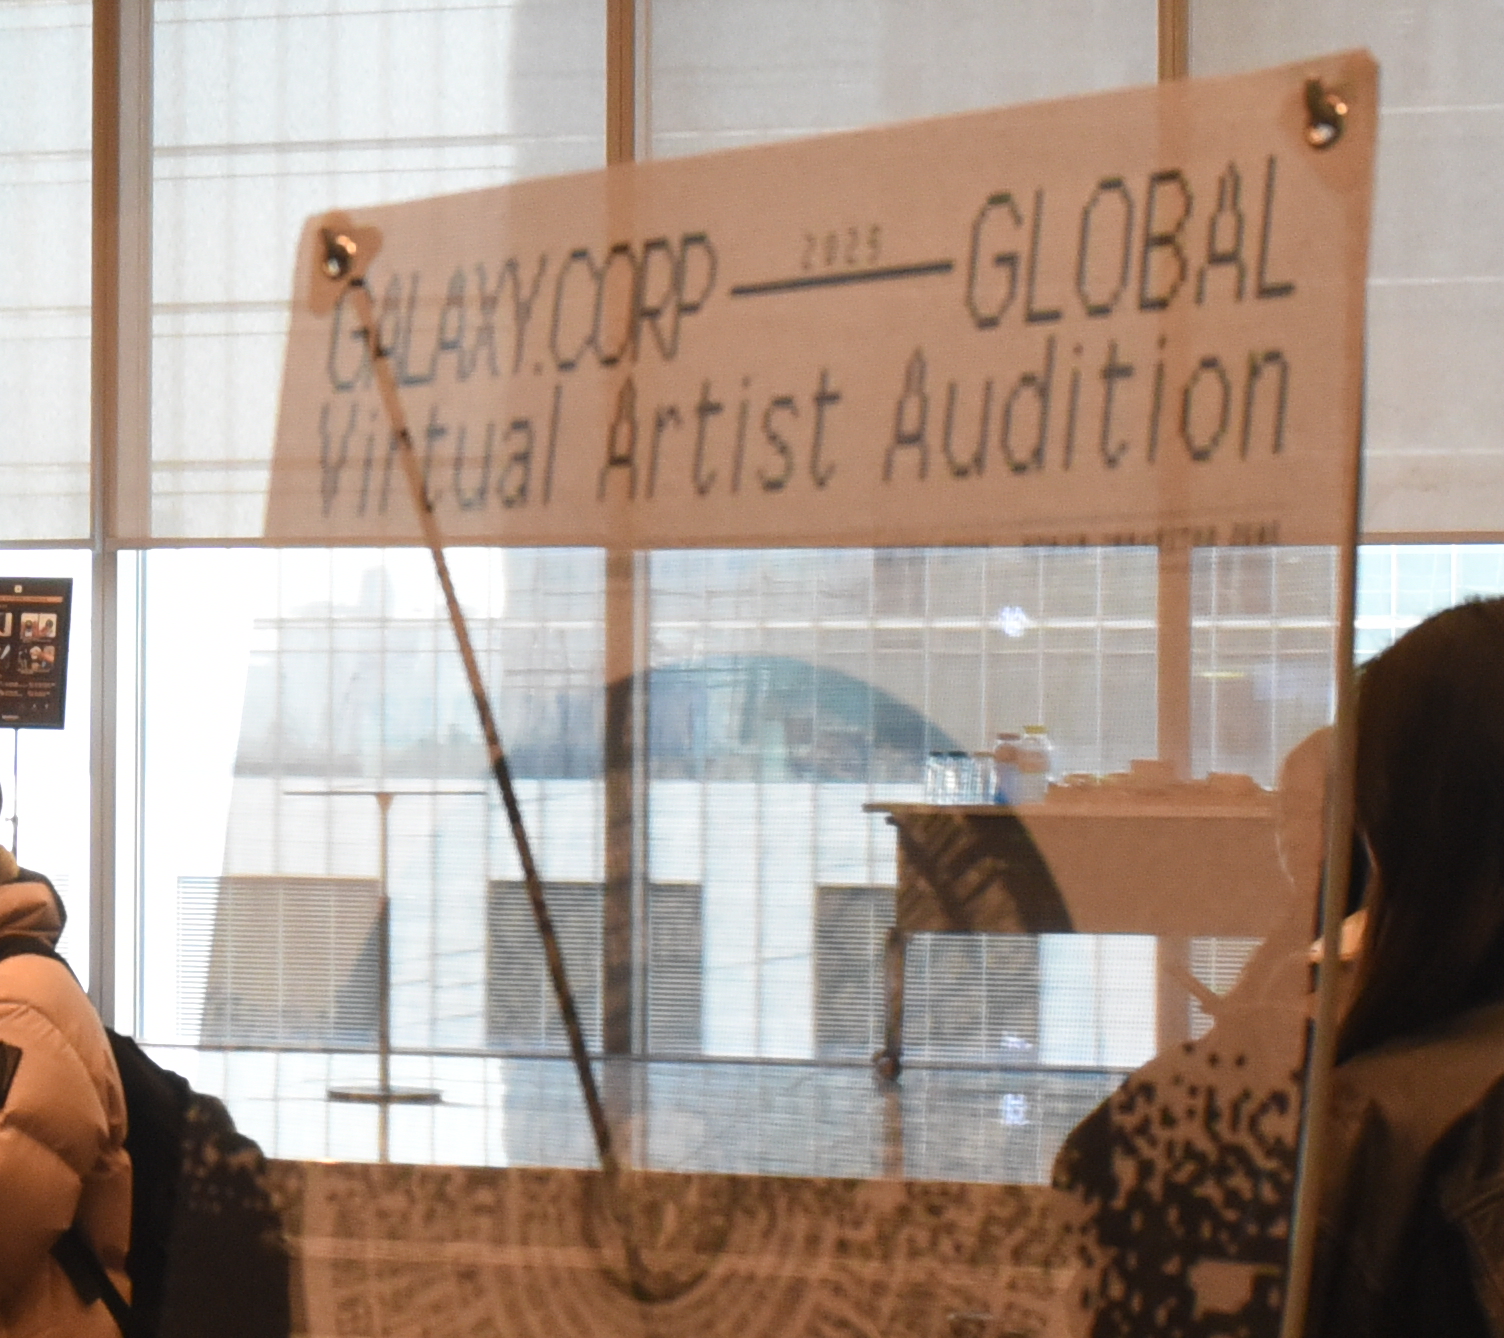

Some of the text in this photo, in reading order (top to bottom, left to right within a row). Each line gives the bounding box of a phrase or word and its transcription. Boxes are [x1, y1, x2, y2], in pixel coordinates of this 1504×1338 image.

[326, 232, 720, 394] GALAXY.CORP
[962, 156, 1297, 331] GLOBAL
[314, 329, 1292, 519] Virtual Artist Audition
